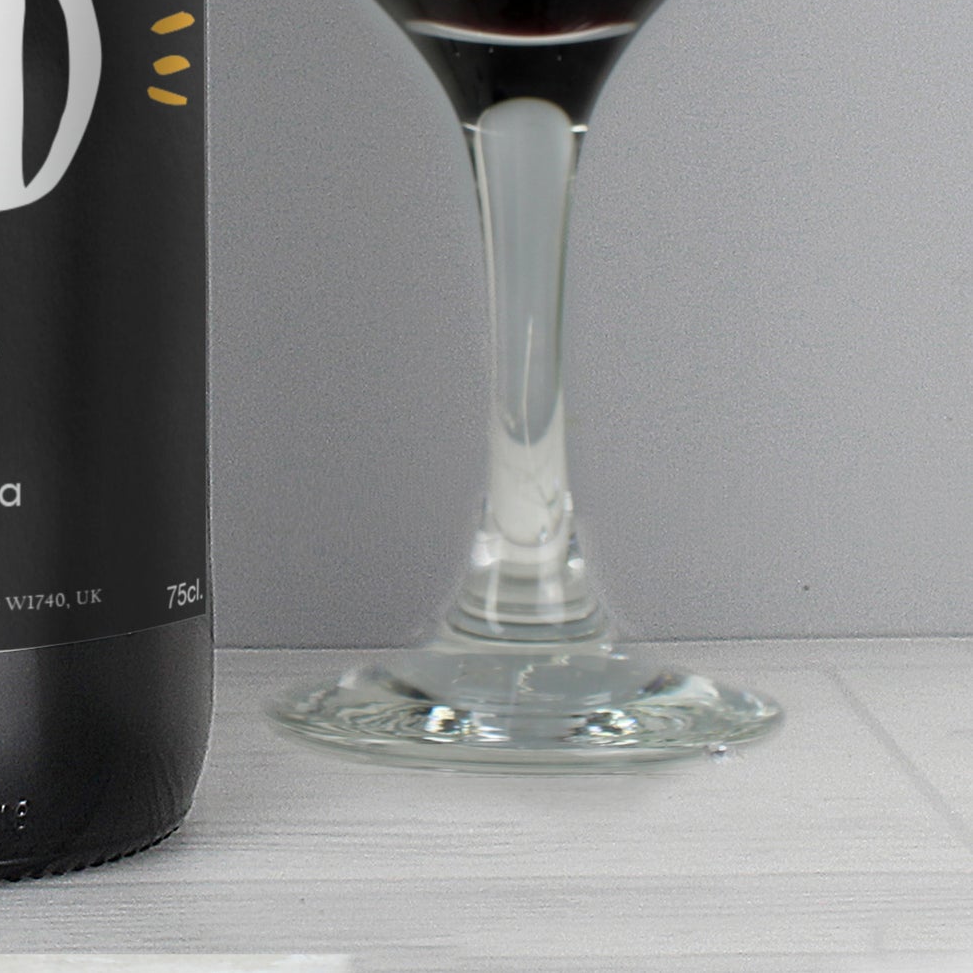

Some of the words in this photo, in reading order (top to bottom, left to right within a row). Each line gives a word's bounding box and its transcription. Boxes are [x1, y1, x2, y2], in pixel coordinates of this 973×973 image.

[5, 591, 71, 611] W1740,
[76, 588, 103, 604] UK
[166, 578, 204, 610] 75cl.
